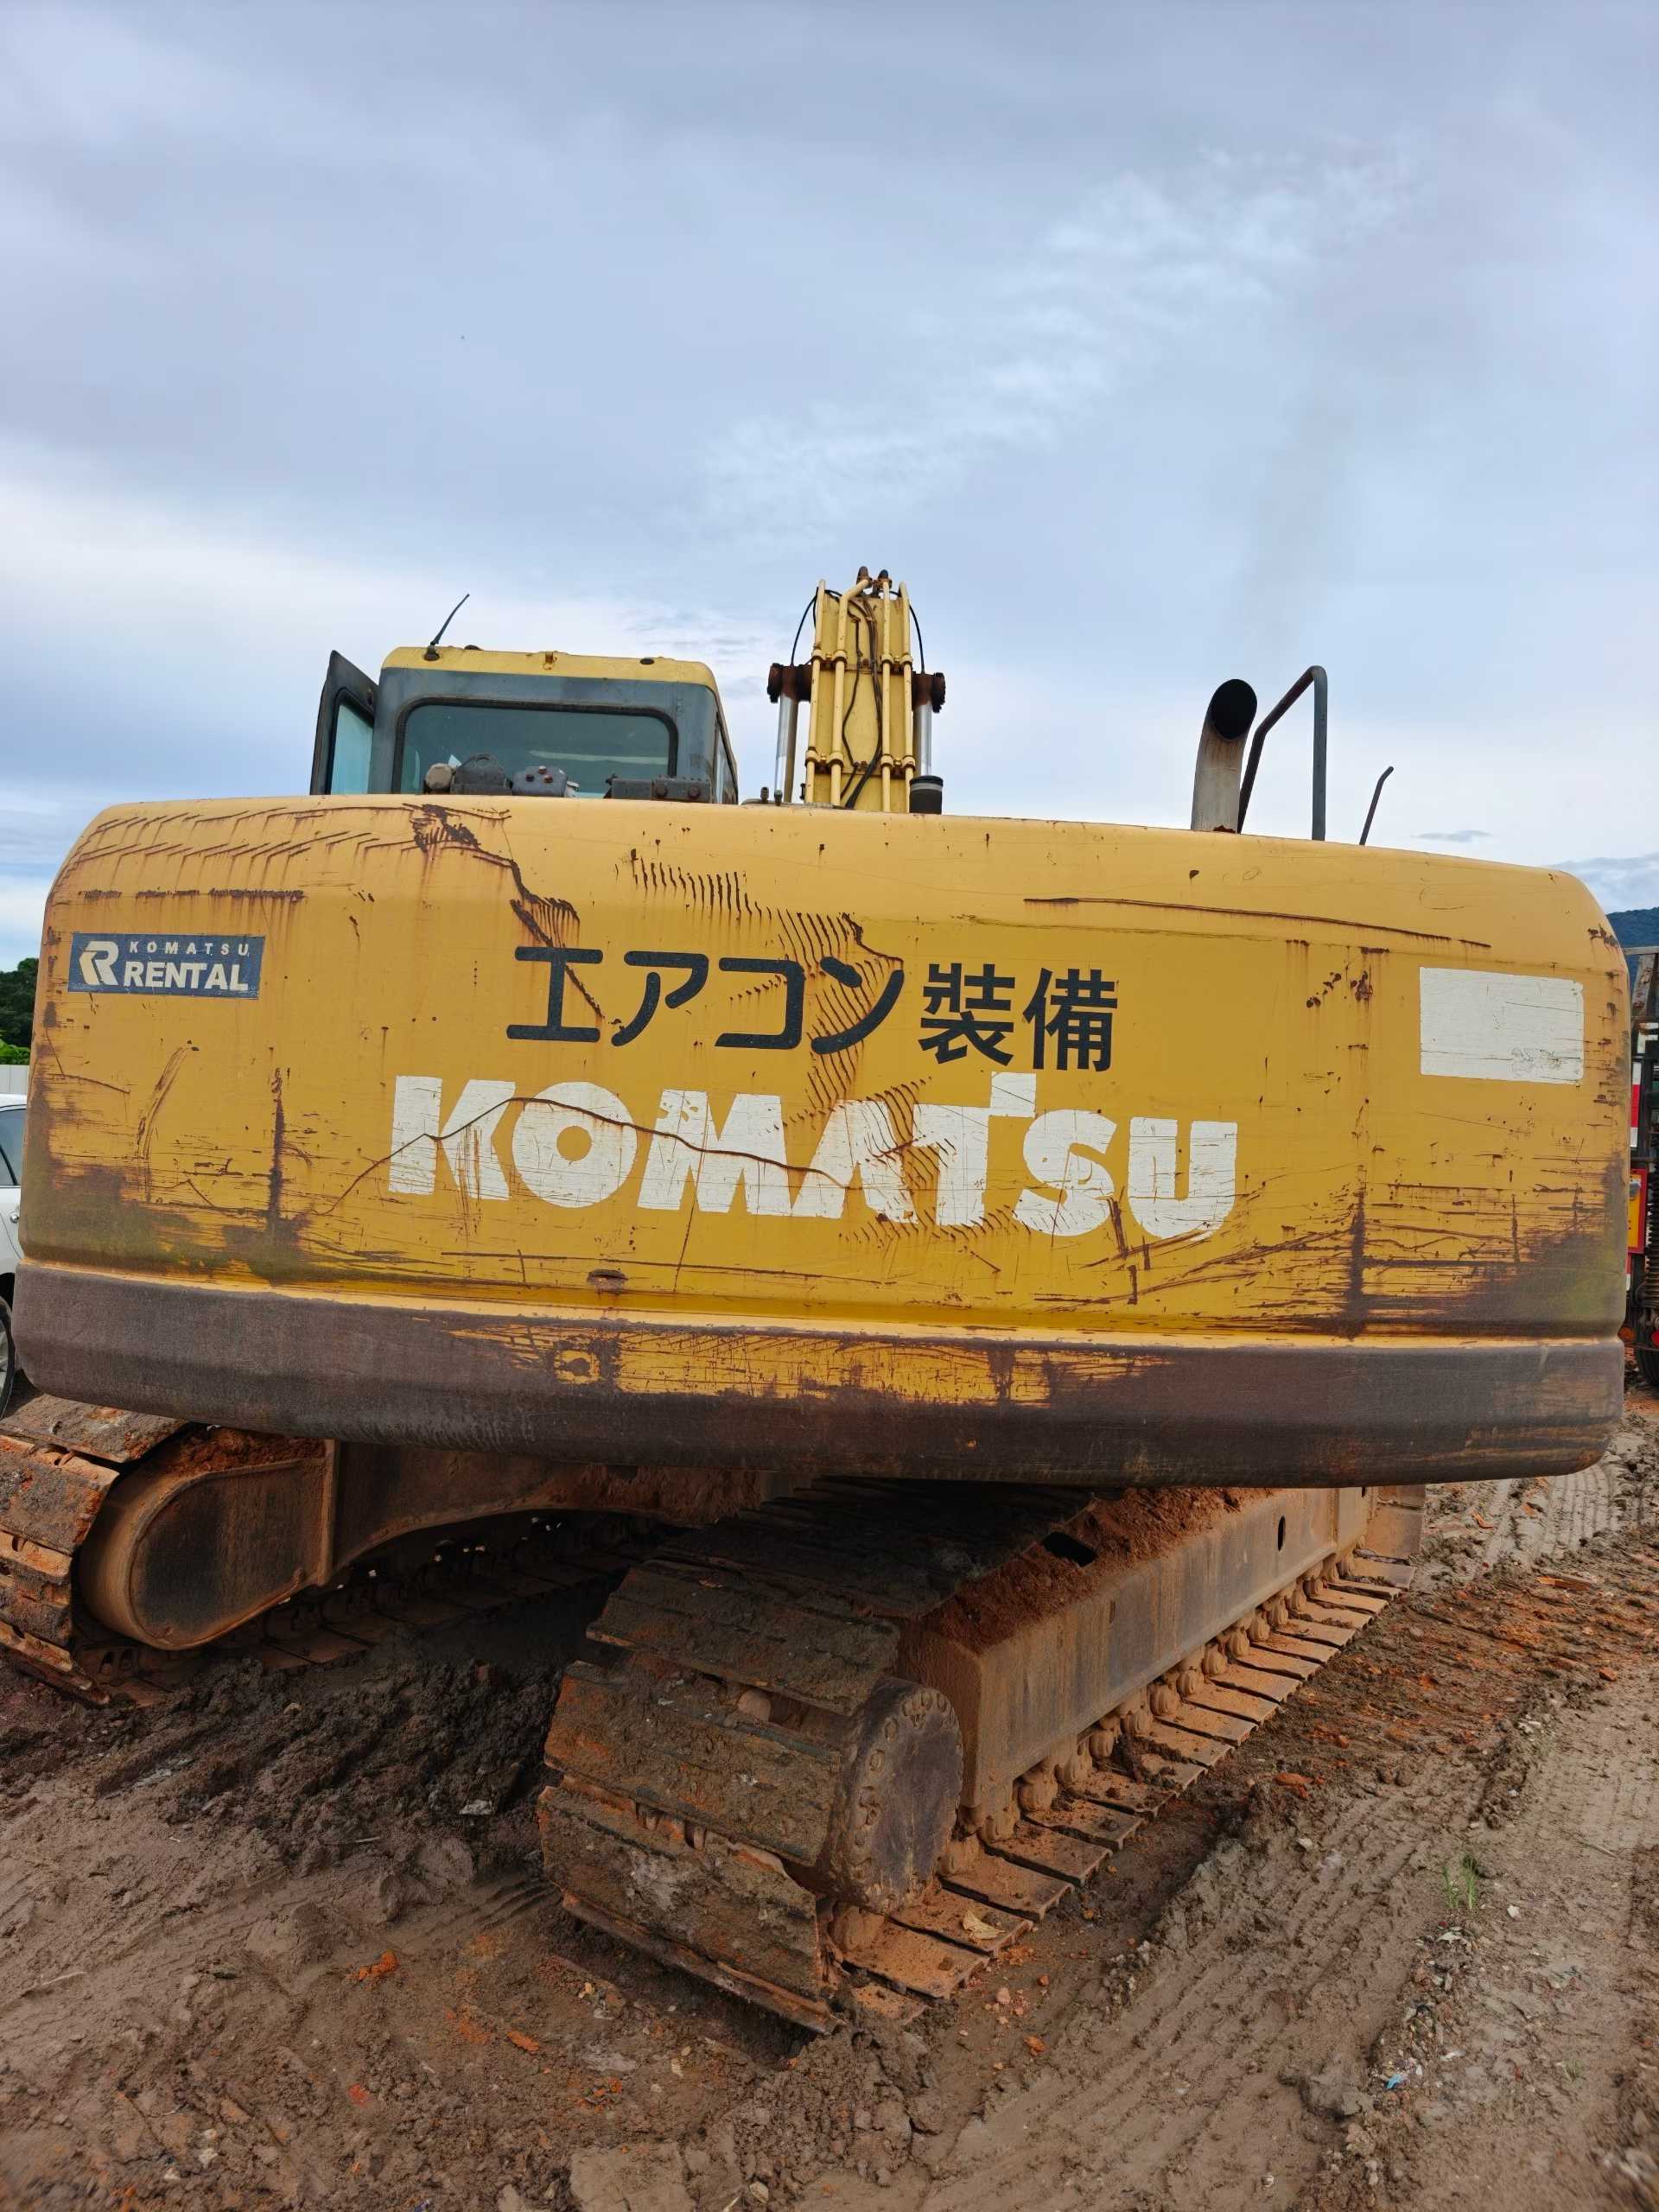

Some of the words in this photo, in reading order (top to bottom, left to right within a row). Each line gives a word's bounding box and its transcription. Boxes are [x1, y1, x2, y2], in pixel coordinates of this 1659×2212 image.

[124, 961, 249, 991] RENTAL
[130, 941, 249, 957] KOMATSU
[506, 946, 1118, 1072] エアコン装備
[387, 1071, 1239, 1240] KOMATSU
